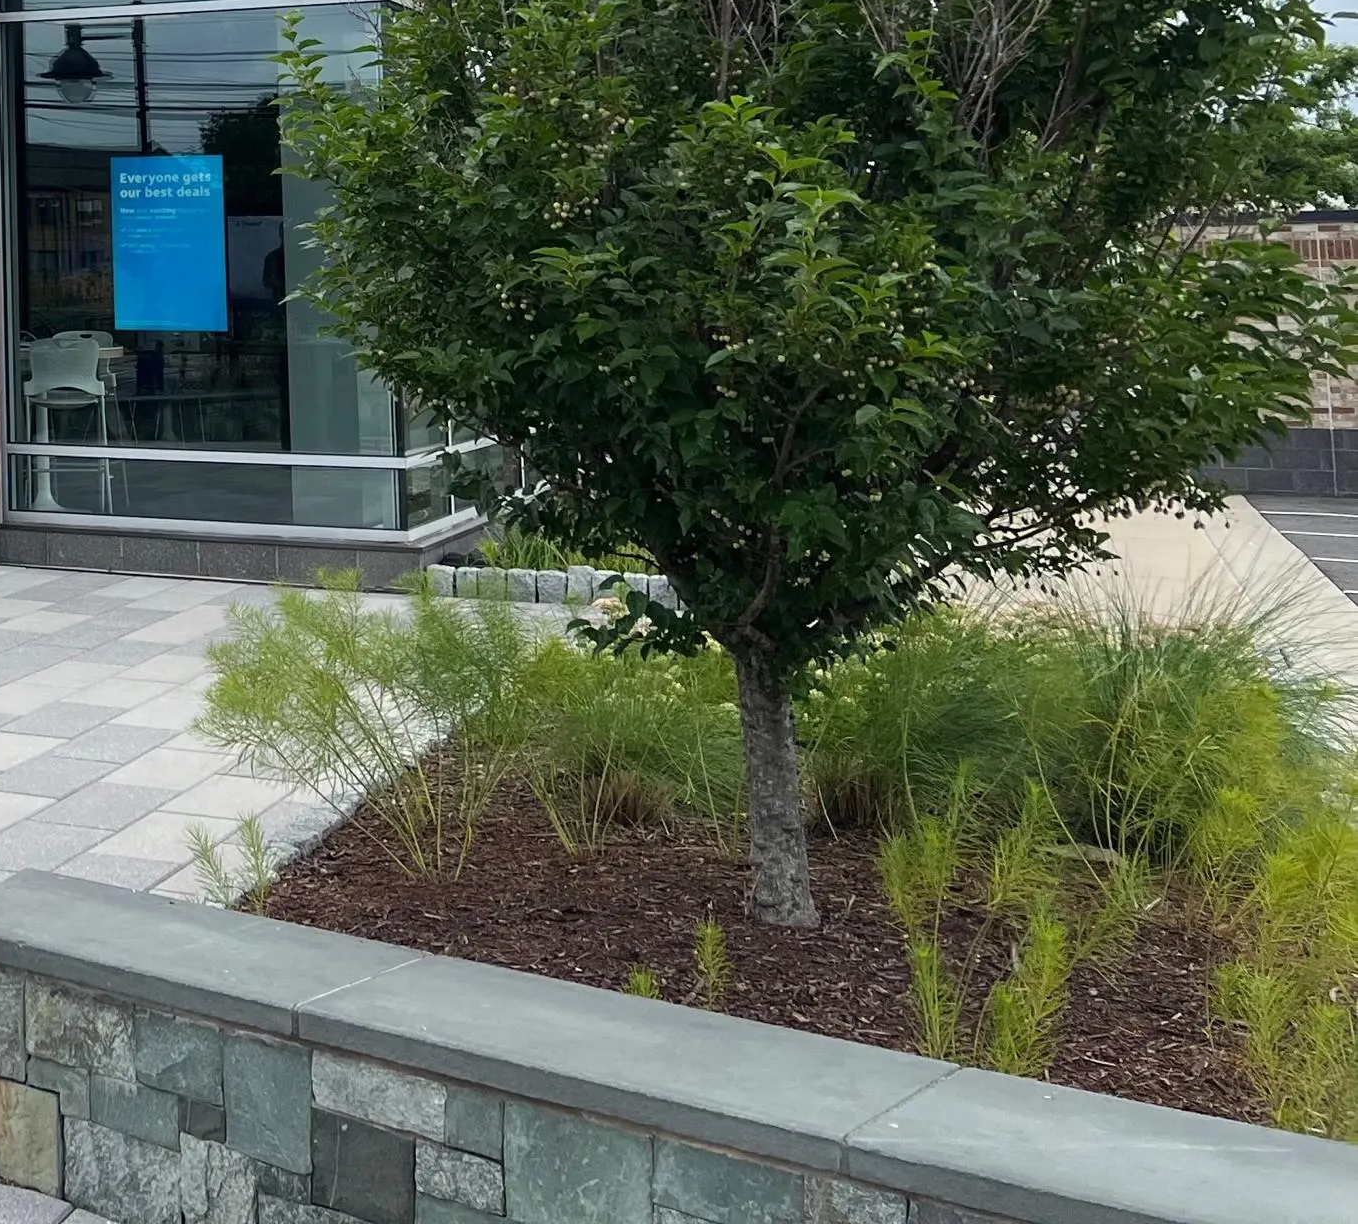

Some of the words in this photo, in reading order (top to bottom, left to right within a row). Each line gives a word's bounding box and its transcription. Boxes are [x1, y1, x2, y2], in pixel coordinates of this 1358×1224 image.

[120, 172, 179, 186] Everyone
[183, 172, 210, 185] gets
[120, 188, 141, 198] our
[145, 187, 172, 197] best
[177, 186, 210, 197] deals
